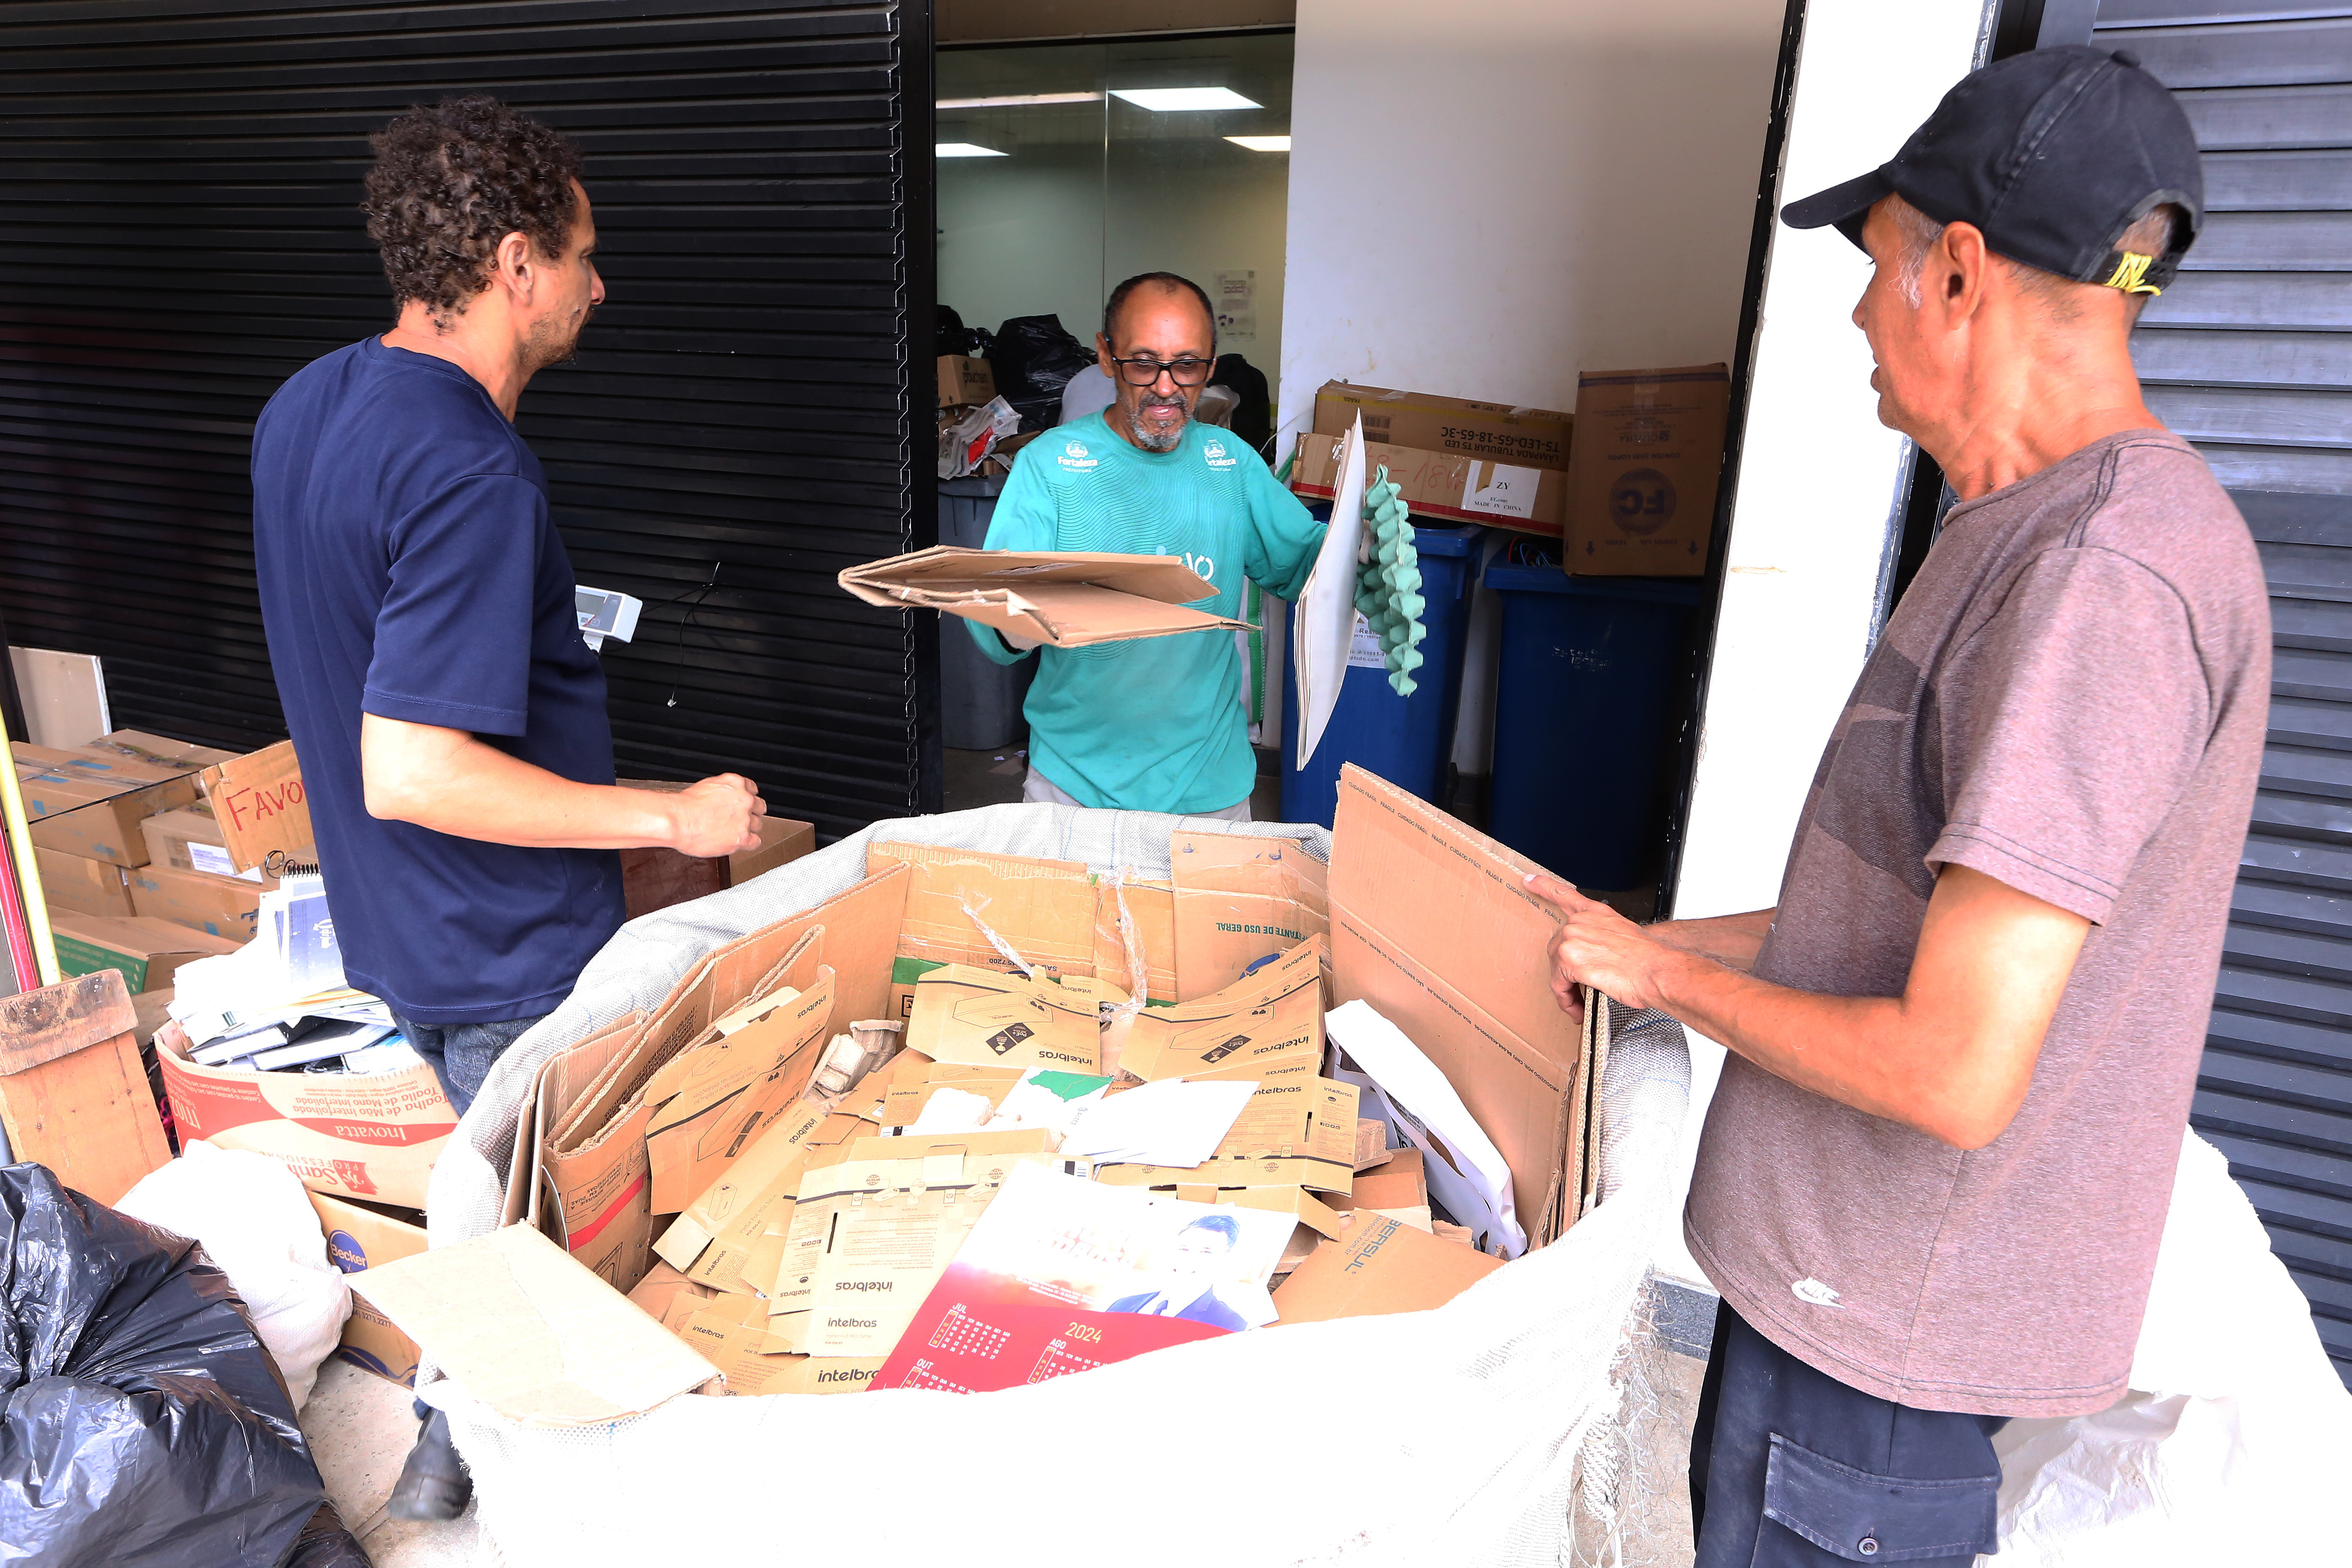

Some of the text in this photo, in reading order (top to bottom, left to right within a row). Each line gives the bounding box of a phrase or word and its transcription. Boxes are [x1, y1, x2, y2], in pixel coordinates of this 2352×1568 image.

[1445, 440, 1460, 448] LED
[1475, 443, 1513, 456] TUBULAR
[1057, 456, 1098, 467] Fortaleza
[1517, 450, 1559, 464] LÂMPADA
[1496, 481, 1510, 490] ZY
[1619, 490, 1665, 515] FC
[226, 779, 305, 831] FAVO
[1348, 781, 1365, 795] CUIDADO
[1380, 801, 1395, 813] FRAGILE
[1397, 812, 1415, 826] CUIDADO
[1431, 833, 1447, 847] FRAGILE
[1449, 846, 1468, 861] CUIDADO
[1485, 869, 1503, 884] FRAGILE
[1505, 883, 1526, 899] CUIDADO
[1544, 908, 1562, 925] FRAGILE
[1216, 922, 1274, 934] DE USO GERAL
[1282, 950, 1312, 971] intelbras
[1395, 963, 1403, 971] DO
[1402, 968, 1415, 981] BENTO
[797, 994, 827, 1019] intelbras
[1449, 1003, 1472, 1025] RUA JORGE
[1253, 1035, 1309, 1055] intelbras
[1038, 1050, 1092, 1066] intelbras
[1265, 1066, 1306, 1076] intelbras
[396, 1080, 417, 1089] Celulosa
[1534, 1072, 1559, 1093] PRODUZIDO
[295, 1086, 439, 1109] Toalla de Mano Interfoliada
[385, 1088, 404, 1097] celulose
[1252, 1086, 1302, 1096] ntelbras
[1324, 1086, 1353, 1098] intelbras
[241, 1094, 261, 1103] Contém
[292, 1093, 449, 1118] Toalha de Mão Interfolhada
[761, 1090, 800, 1129] intelbras
[334, 1125, 407, 1141] Inovatta
[789, 1118, 818, 1144] intelbras
[571, 1196, 586, 1206] DUAS
[331, 1243, 367, 1267] Becker
[704, 1250, 726, 1276] intelbras
[780, 1289, 811, 1297] intelbras
[835, 1281, 893, 1292] intelbras
[1803, 1276, 1840, 1301] NIKE
[952, 1303, 967, 1314] JUL
[828, 1317, 877, 1327] intelbras
[692, 1325, 725, 1339] intelbras
[1065, 1322, 1102, 1344] 2024
[1050, 1338, 1066, 1349] AGO
[917, 1358, 934, 1370] OUT
